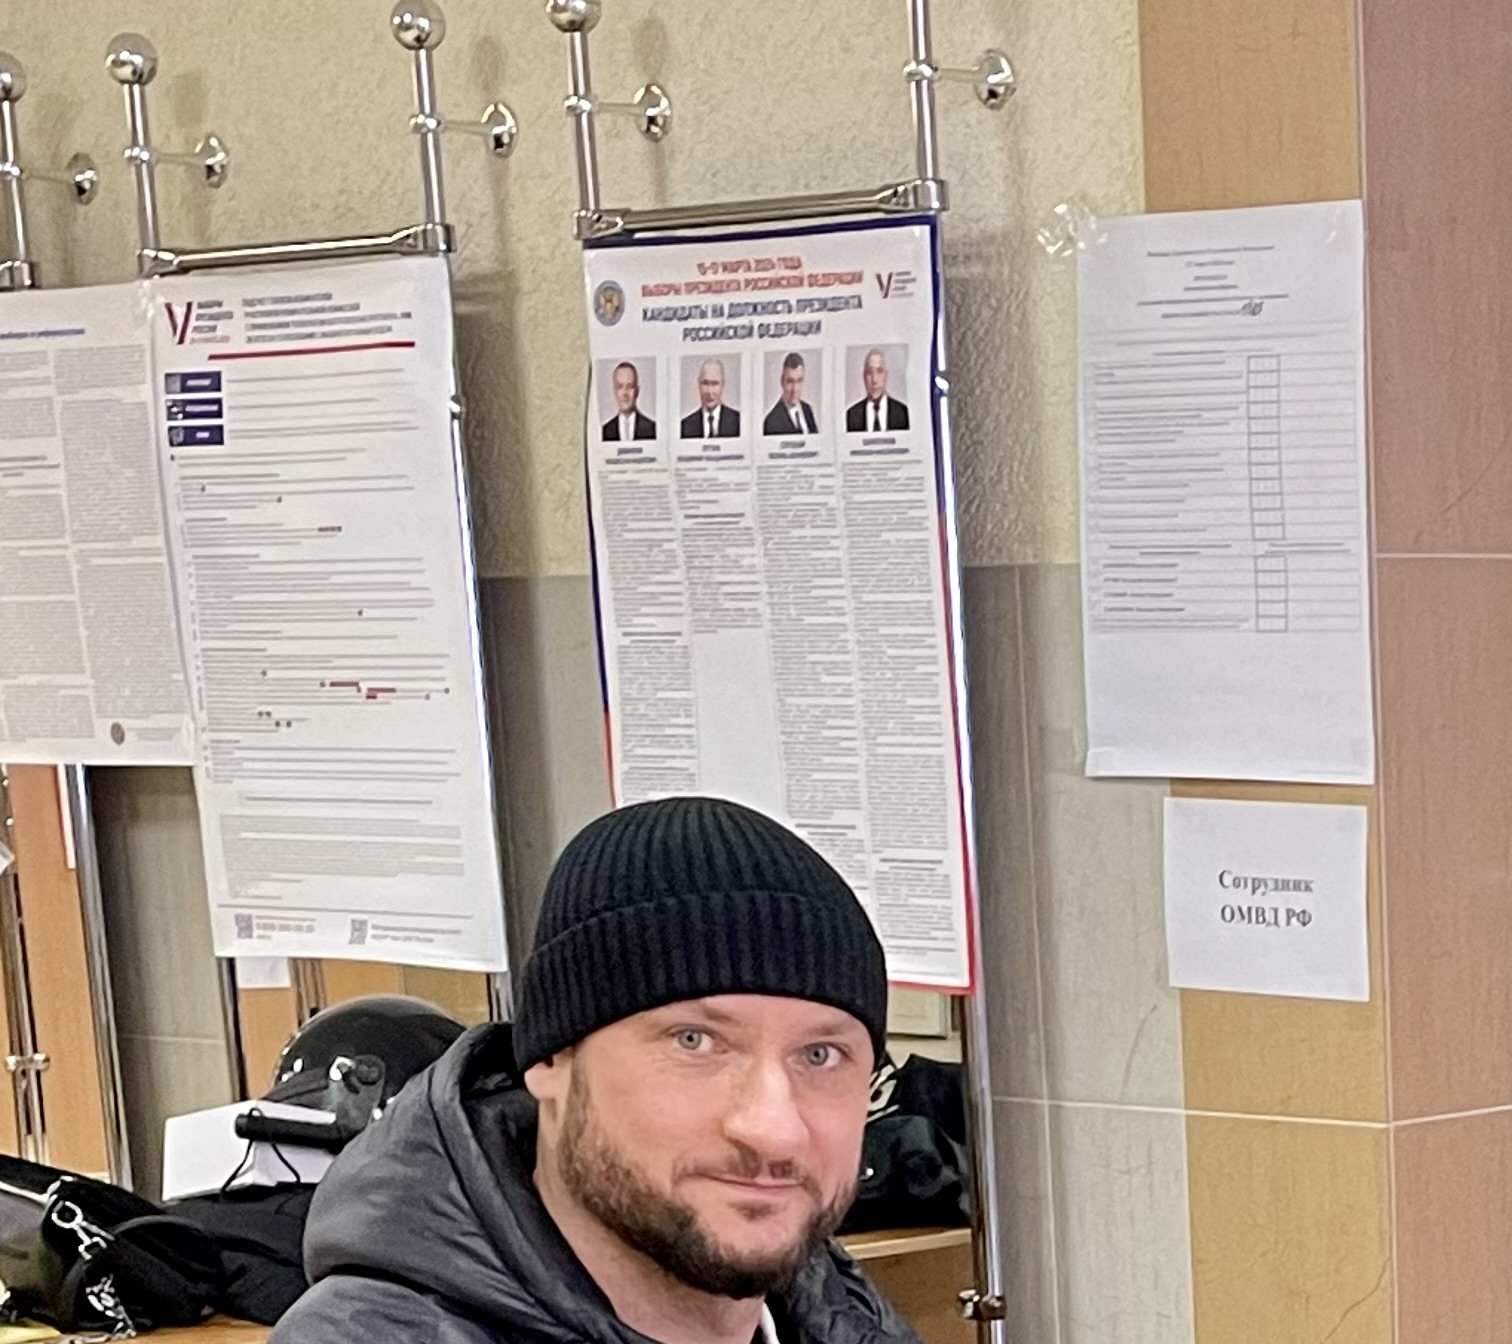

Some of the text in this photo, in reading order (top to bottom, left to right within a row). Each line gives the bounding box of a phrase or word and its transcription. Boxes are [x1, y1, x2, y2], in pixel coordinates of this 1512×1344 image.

[641, 283, 682, 298] ВЫБОРЫ
[683, 279, 741, 295] ПРЕЗИДЕНТА
[641, 294, 863, 323] КАНДИДАТЫ НА ДОЛЖНОСТЬ ПРЕЗИДЕНТА
[682, 319, 822, 342] РОССИЙСКОЙ ФЕДЕРАЦИИ
[1218, 869, 1314, 897] Сотрудник
[1220, 904, 1313, 929] ОМВД РФ
